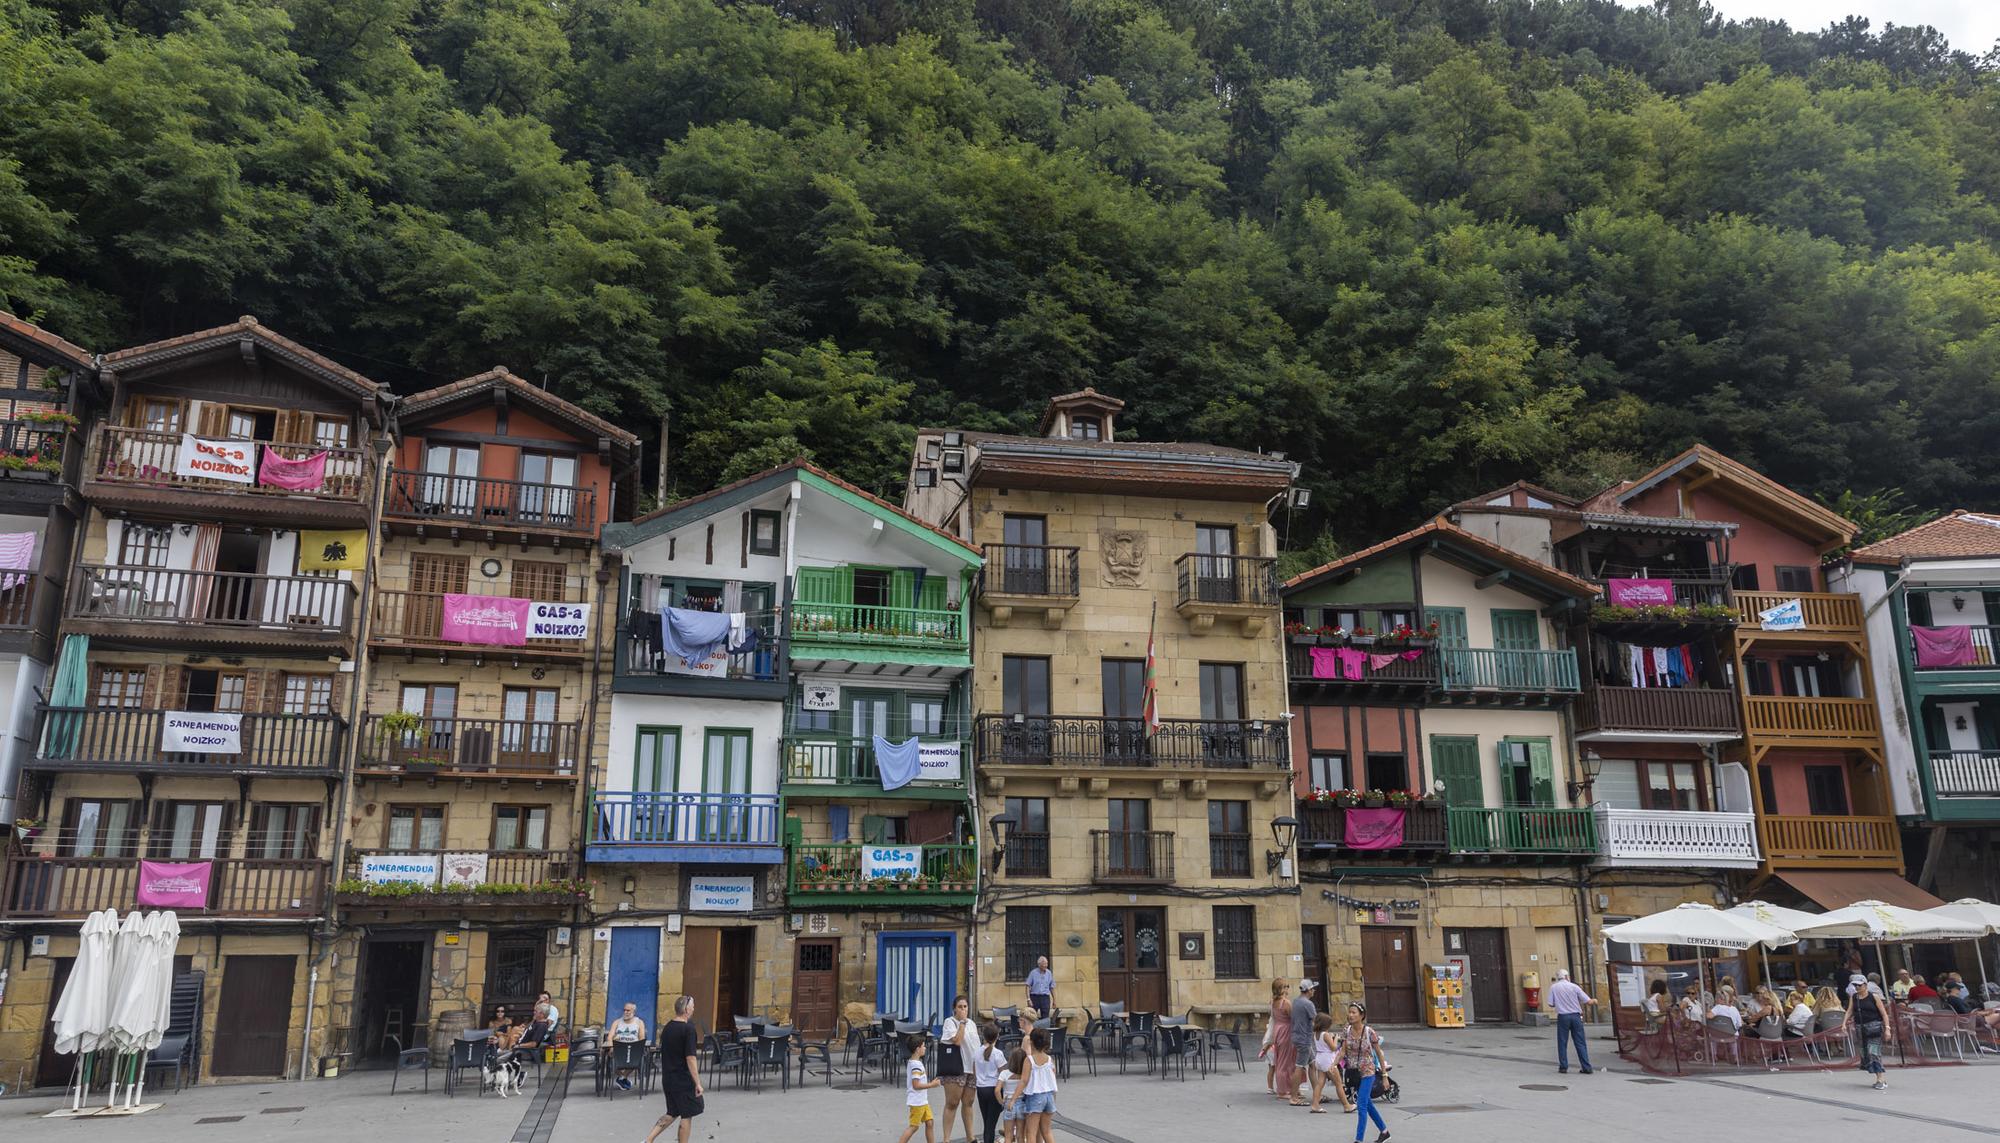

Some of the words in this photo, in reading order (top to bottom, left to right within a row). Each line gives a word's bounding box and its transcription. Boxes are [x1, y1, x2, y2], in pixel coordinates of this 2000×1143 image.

[190, 459, 250, 476] NOIZKO?
[537, 605, 582, 619] GAS-a
[534, 623, 586, 637] NOIZKO?
[183, 736, 226, 745] NOIZKO?
[872, 849, 913, 862] GAS-a
[366, 863, 434, 873] SANEAMENDUA
[694, 884, 752, 893] SANEAMENDUA
[705, 897, 740, 905] NOIZKO?
[1687, 936, 1719, 946] CERVEZAS
